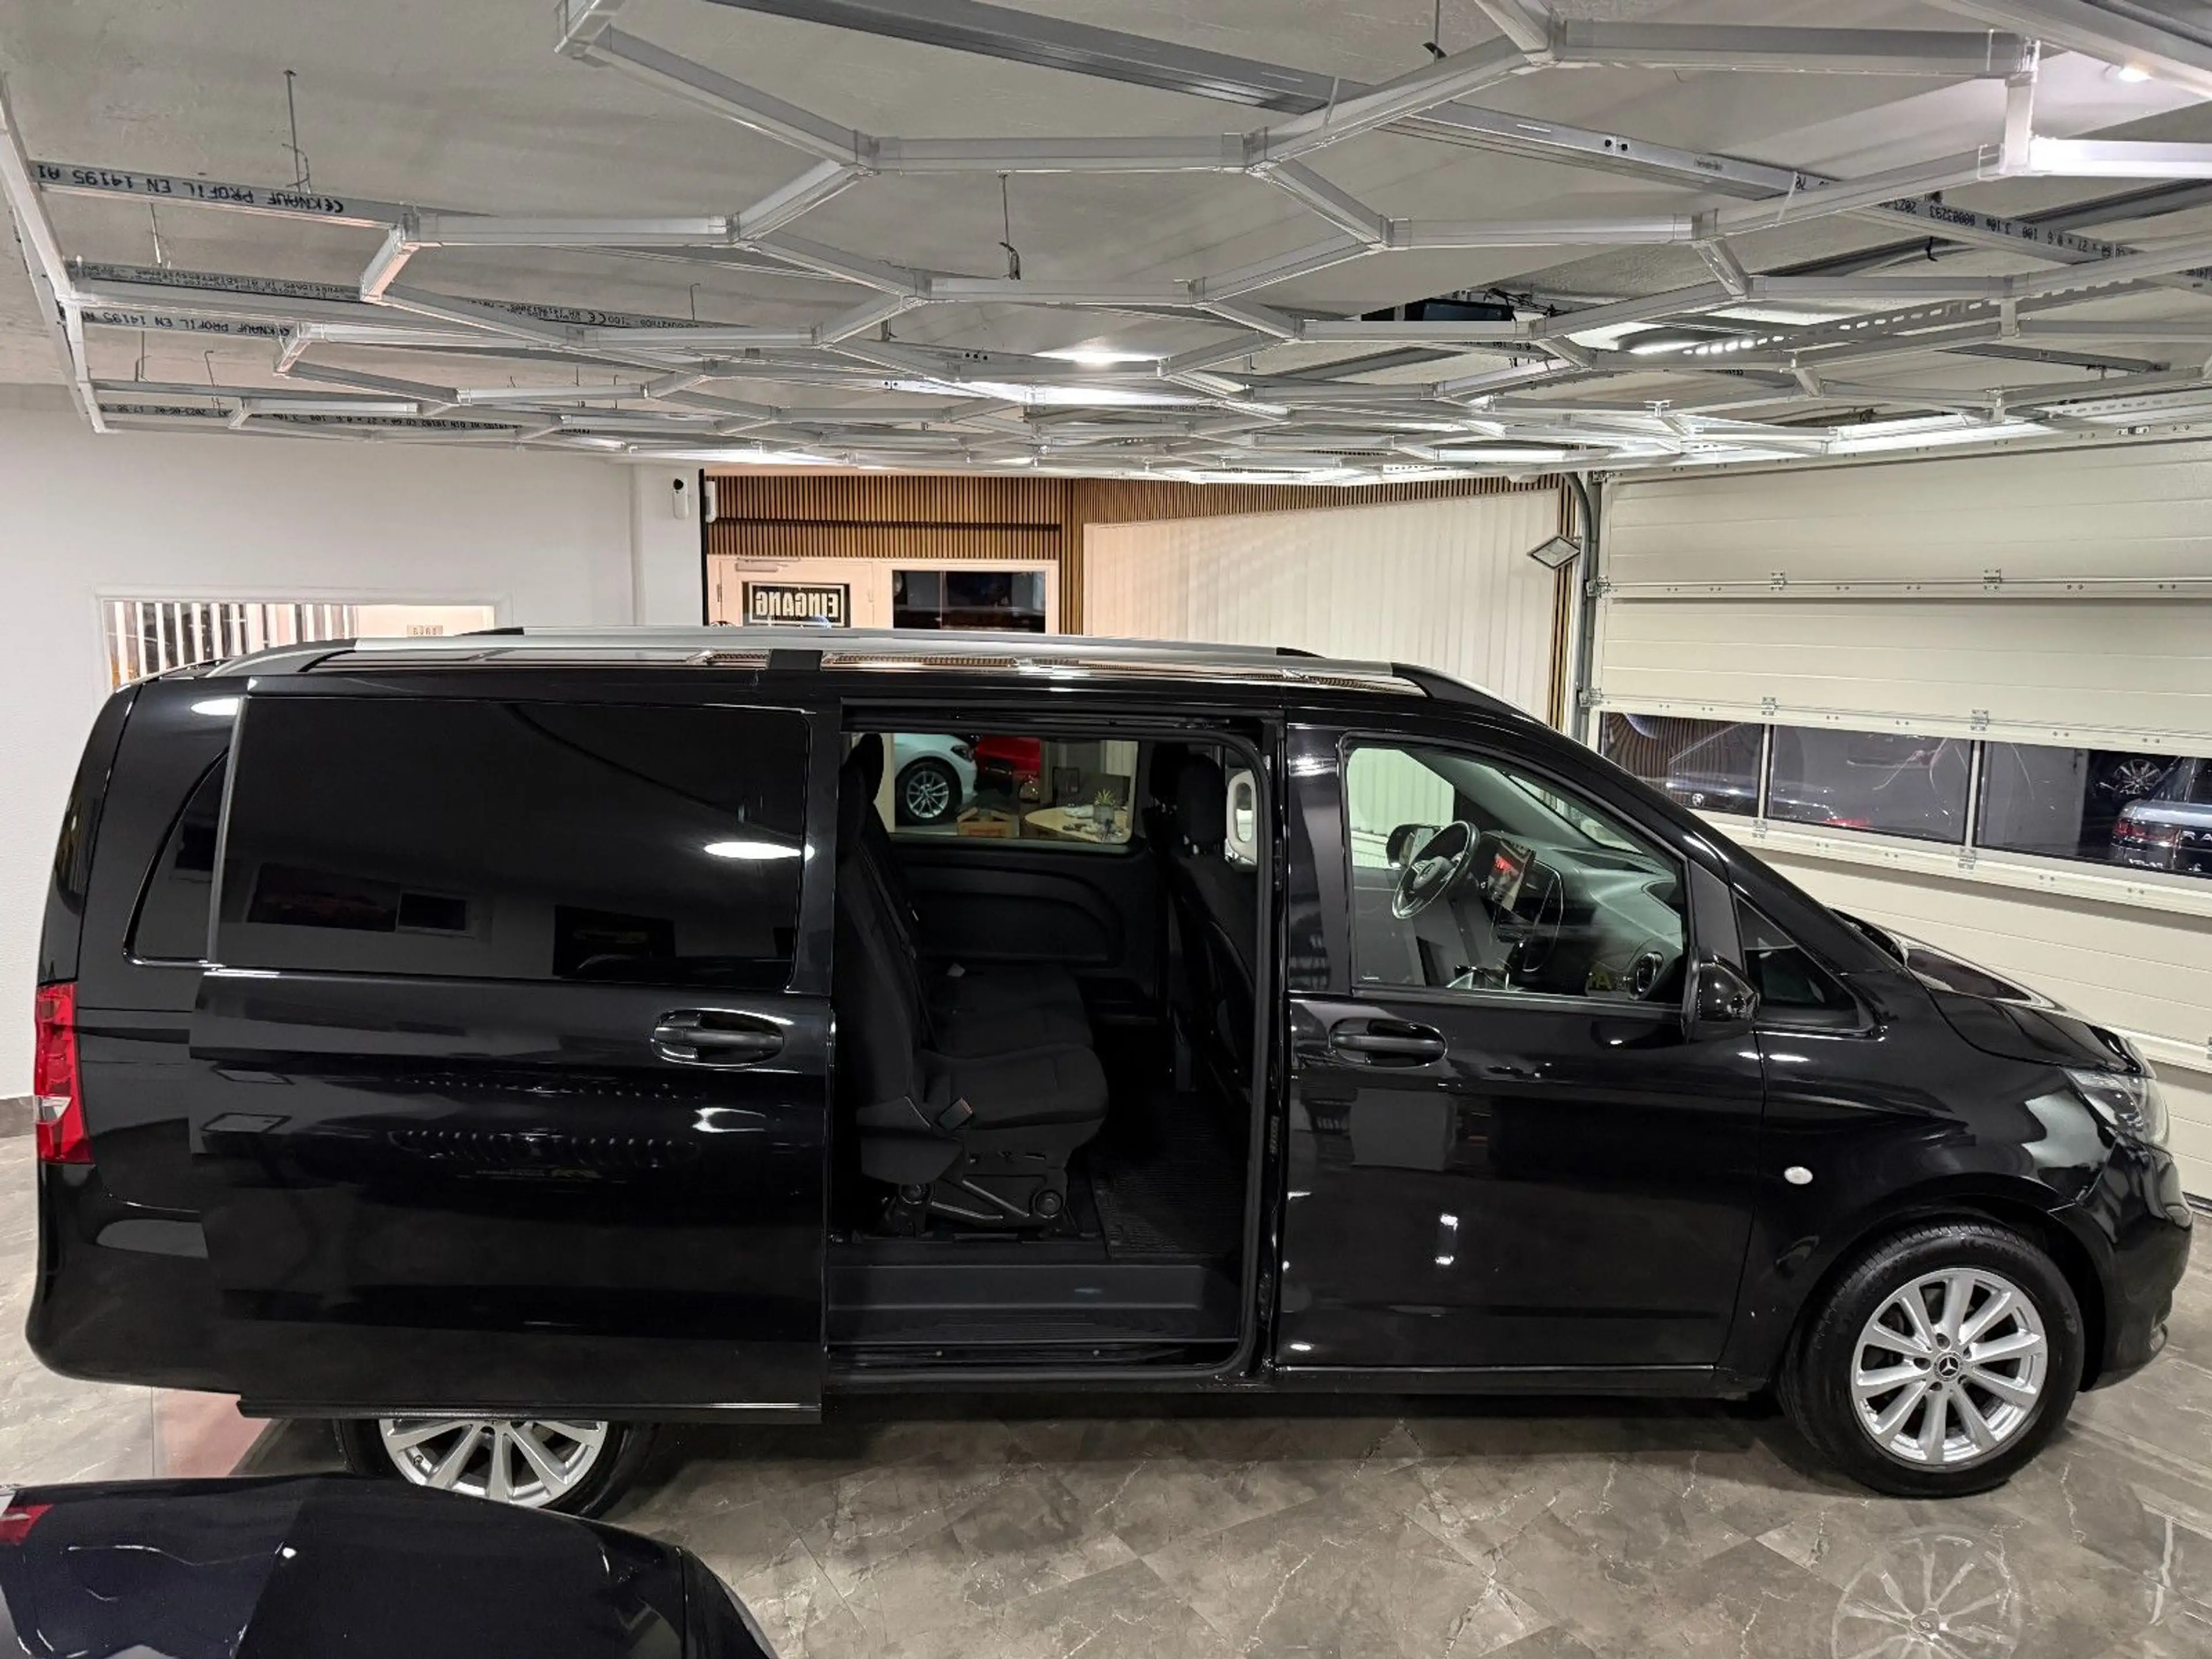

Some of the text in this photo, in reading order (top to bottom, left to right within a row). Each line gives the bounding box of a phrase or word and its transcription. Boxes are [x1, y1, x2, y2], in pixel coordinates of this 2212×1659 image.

[72, 170, 134, 190] 14195
[146, 178, 172, 194] EN
[182, 182, 254, 204] PROFIL
[267, 192, 322, 210] KNAUF
[103, 312, 146, 325] 14195
[154, 316, 173, 327] EN
[180, 319, 229, 332] PROFIL
[236, 323, 275, 336] KNAUF
